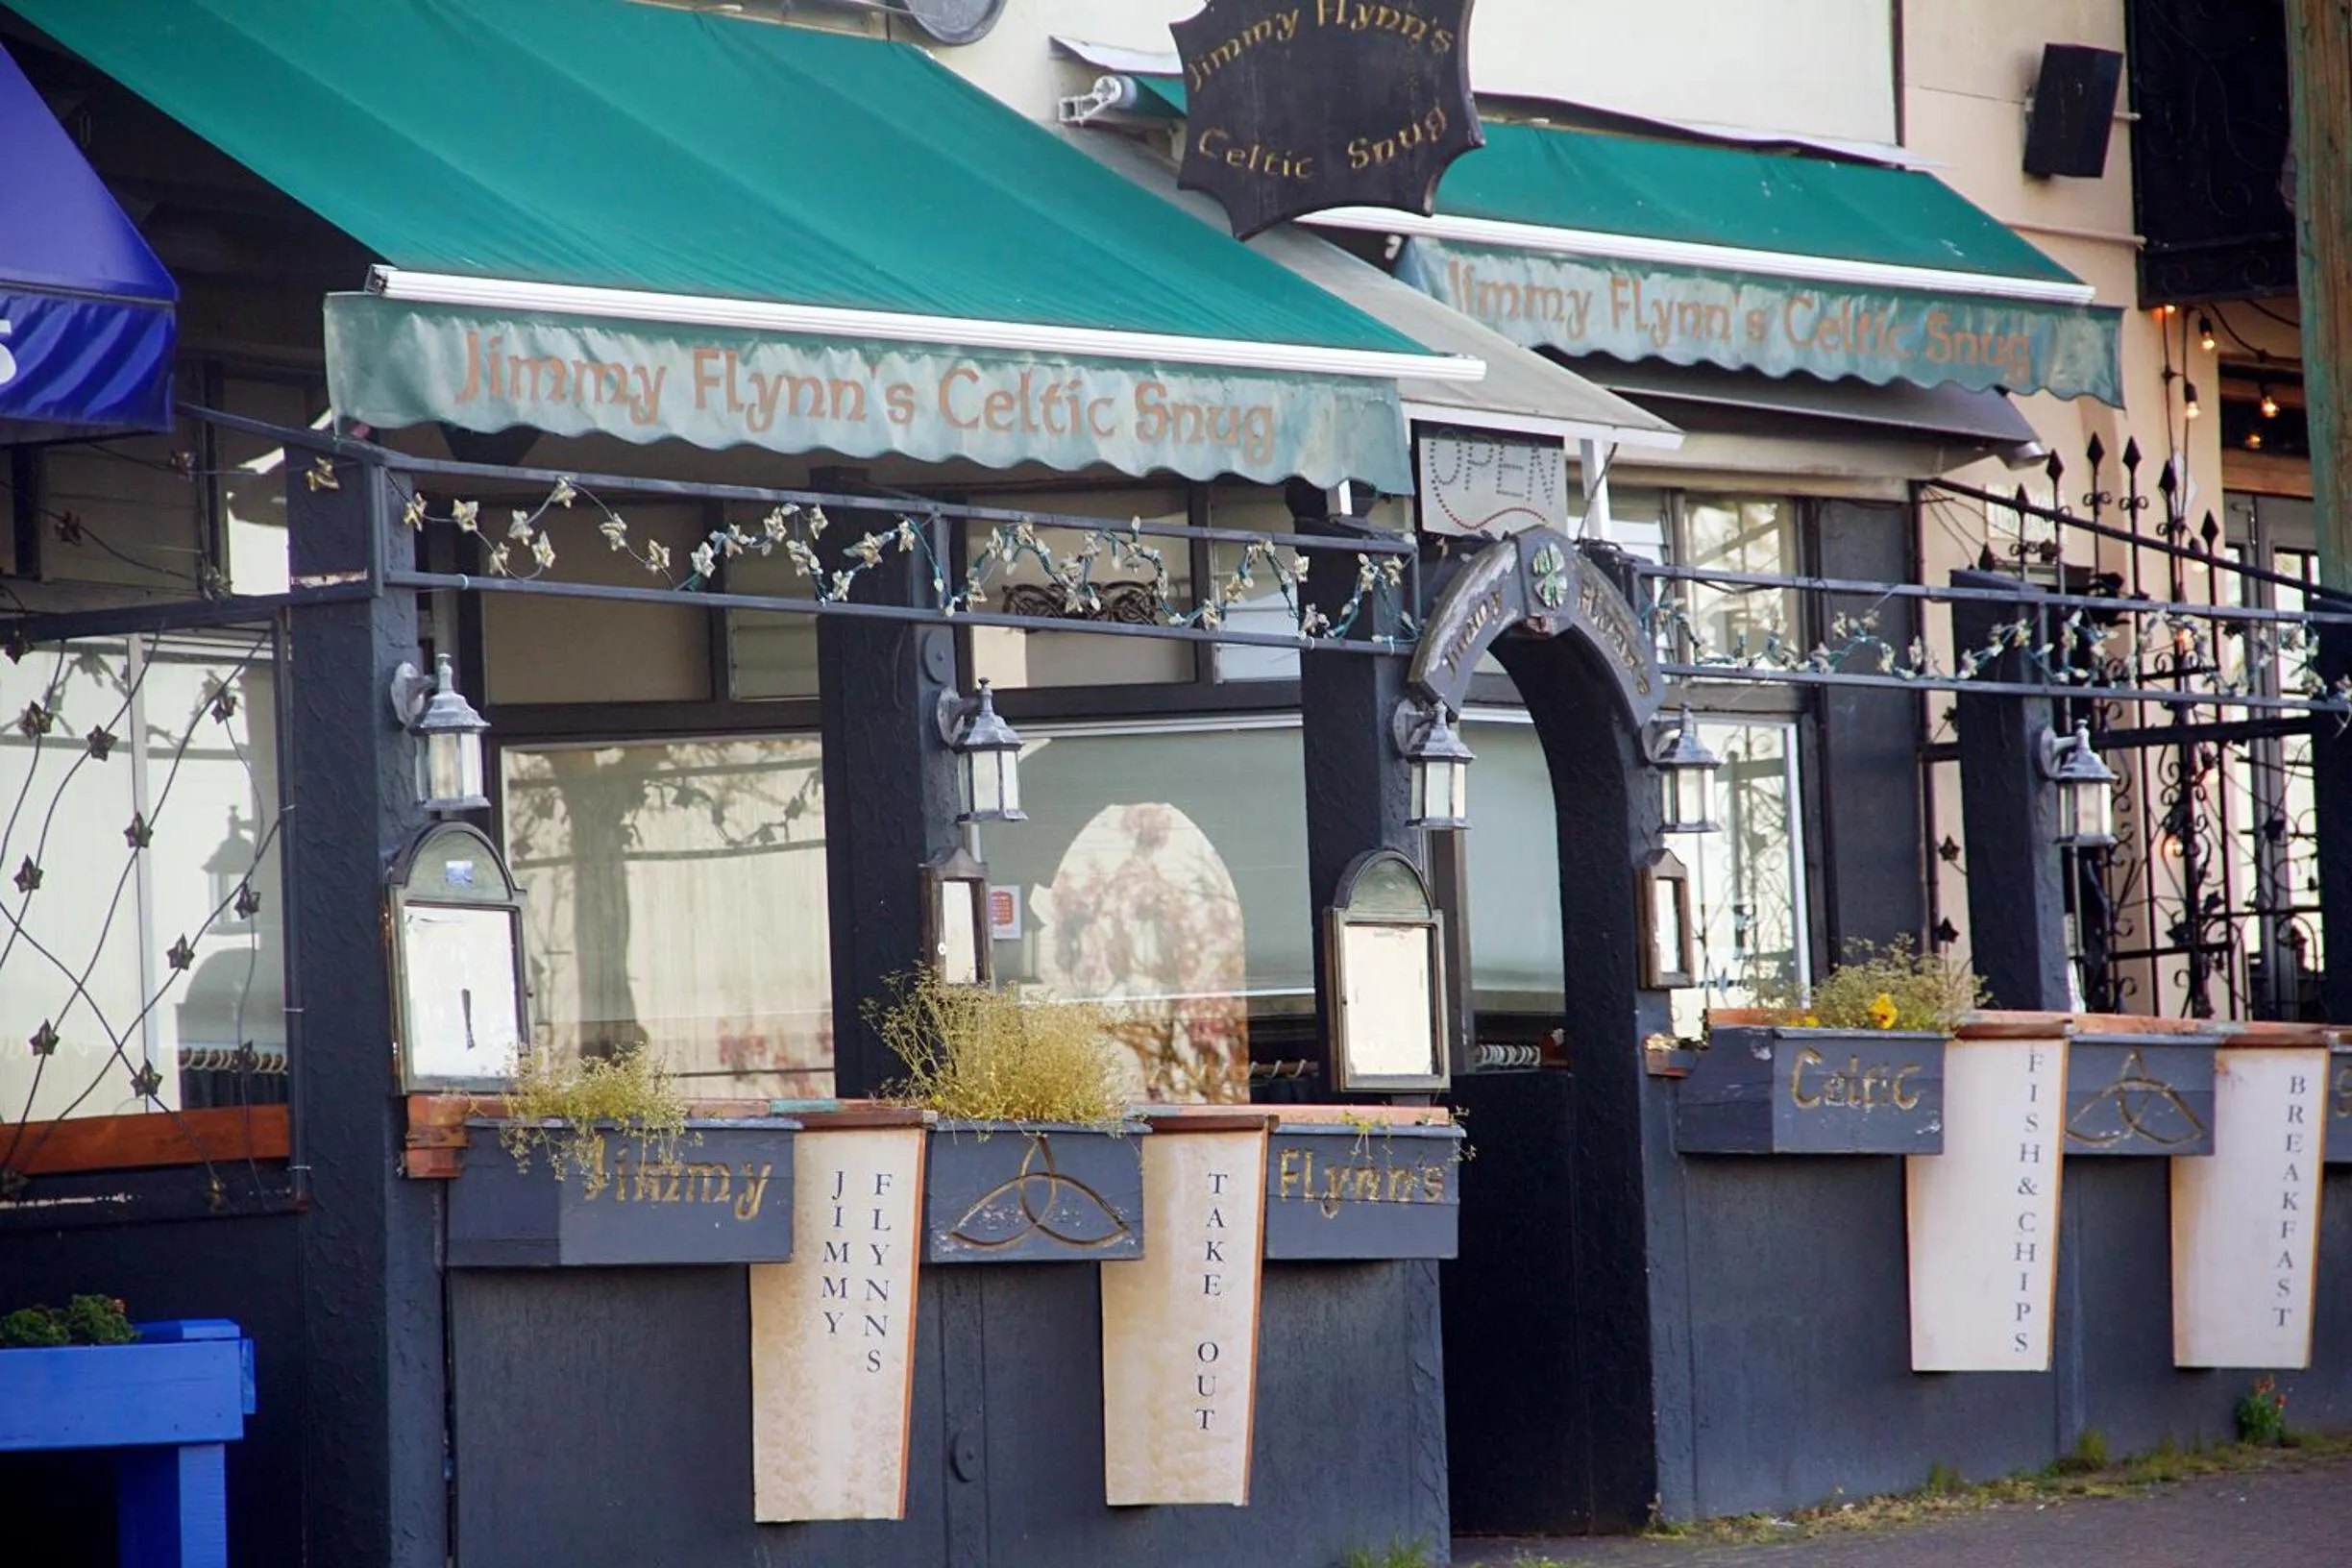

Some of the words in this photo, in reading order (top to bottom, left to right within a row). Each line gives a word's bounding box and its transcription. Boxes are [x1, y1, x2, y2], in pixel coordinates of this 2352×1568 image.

[1188, 9, 1299, 92] Jimmy
[1198, 127, 1314, 180] Celtic
[1347, 106, 1447, 170] Snug
[1610, 274, 1768, 348] Flynn's
[1784, 296, 1915, 359] Celtic
[1925, 309, 2030, 384] Snug
[454, 331, 667, 426] Jimmy
[692, 346, 915, 433] Flynn's
[938, 366, 1115, 438] Celtic
[1135, 380, 1275, 465] Snug
[1430, 429, 1559, 505] OPEN
[1791, 1047, 1923, 1112] Celtic
[584, 1135, 772, 1219] Jimmy
[2272, 1075, 2306, 1328] BREAKFAST
[821, 1169, 849, 1335] JIMMY
[865, 1172, 894, 1374] FLYNNS
[1203, 1172, 1229, 1298] TAKE
[1196, 1340, 1220, 1433] OUT
